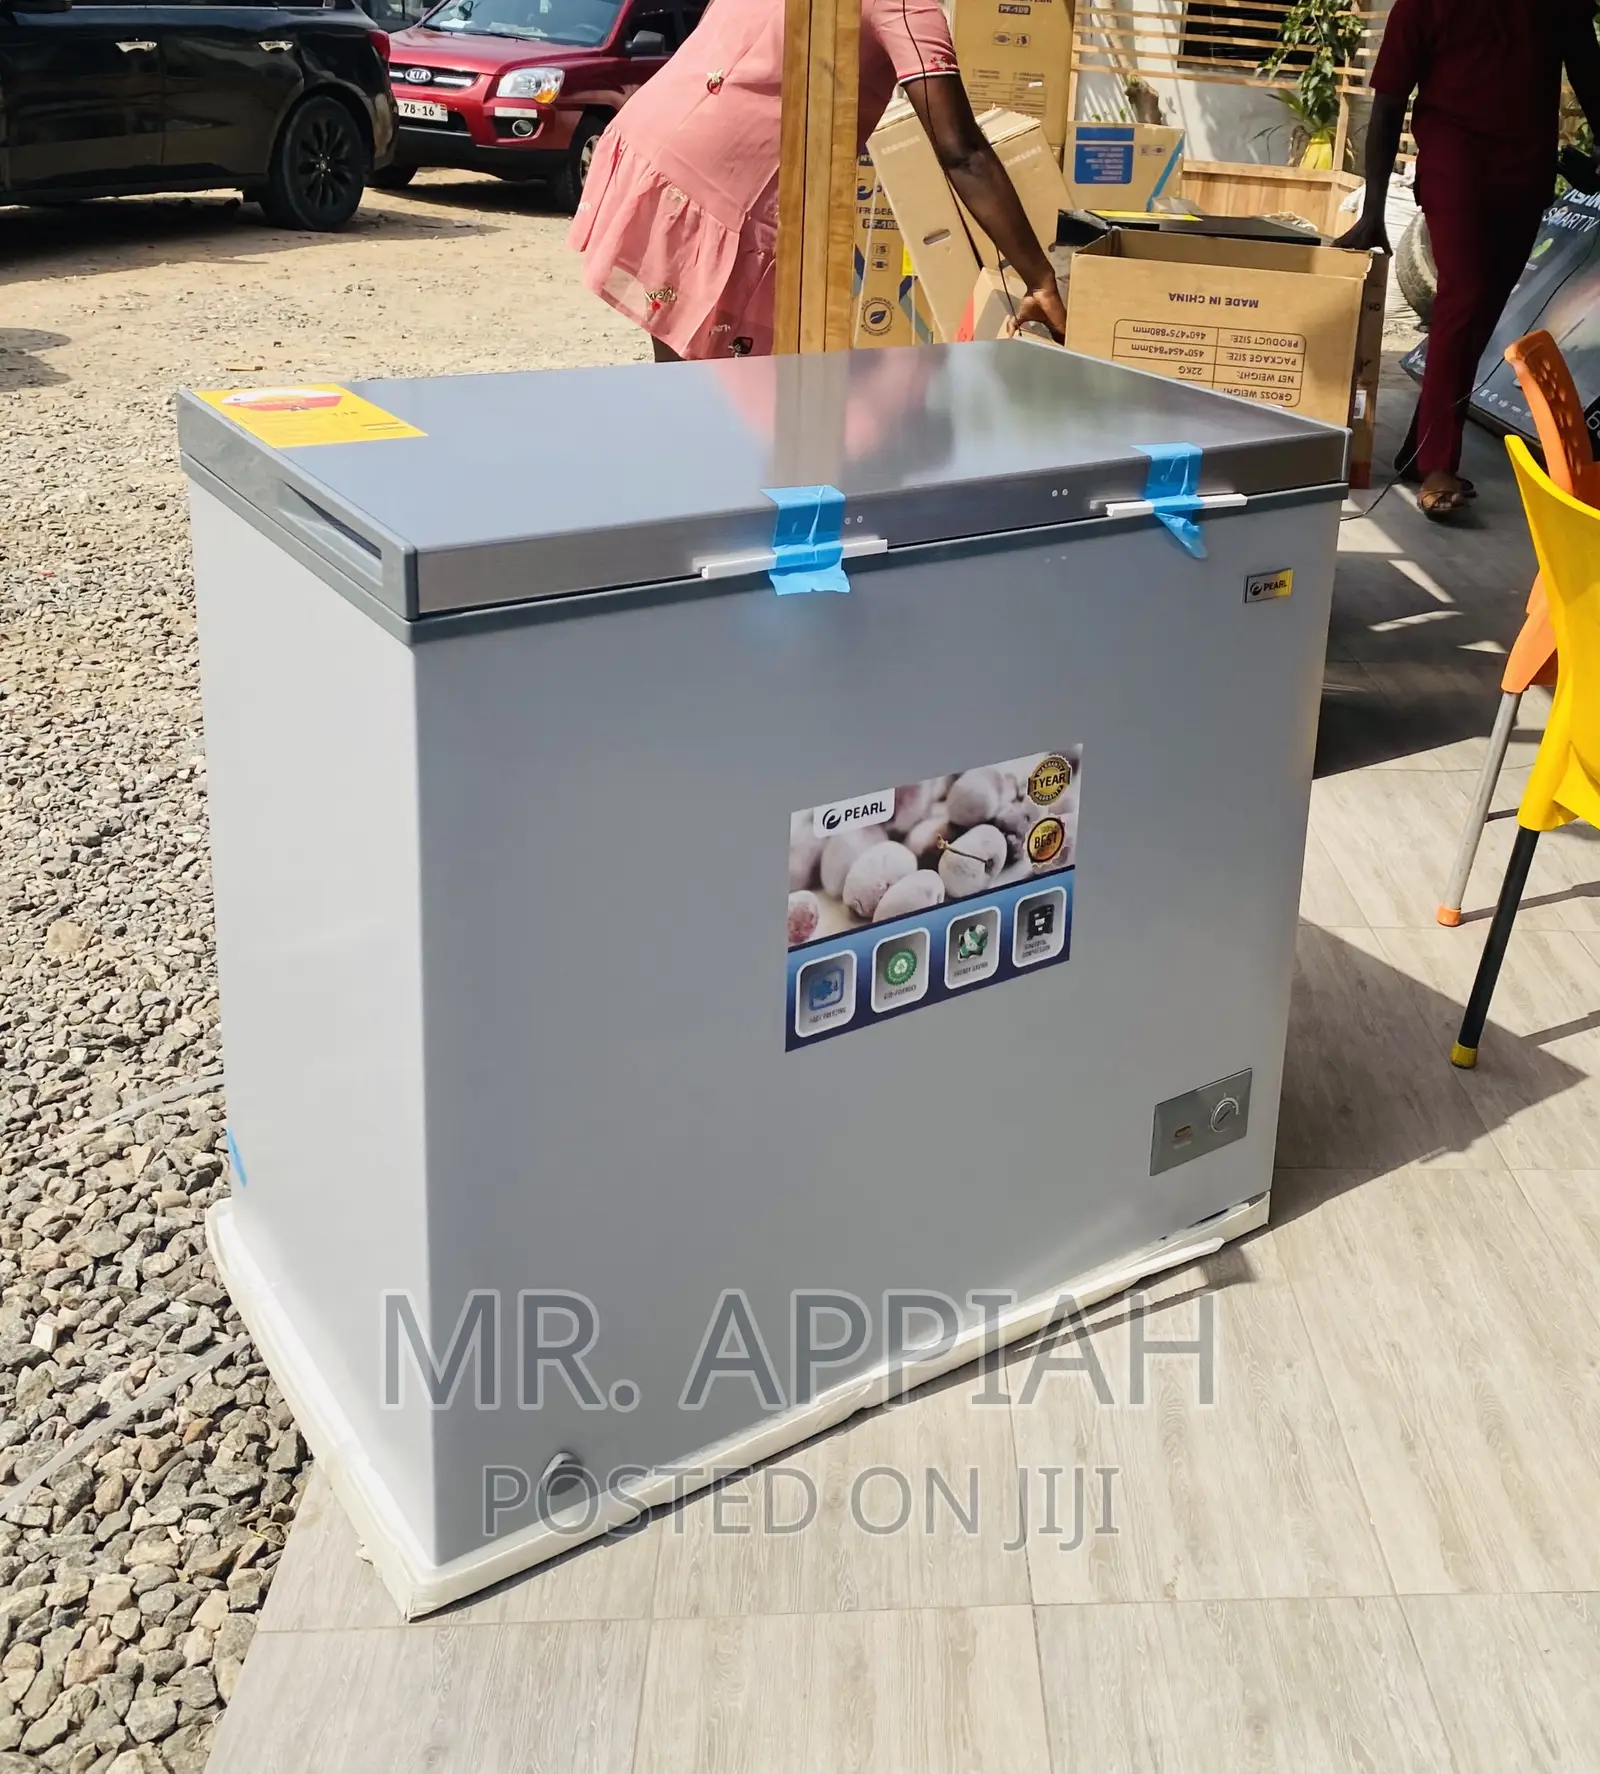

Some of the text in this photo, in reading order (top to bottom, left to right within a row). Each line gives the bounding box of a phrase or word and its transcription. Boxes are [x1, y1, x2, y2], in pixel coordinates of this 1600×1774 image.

[409, 70, 427, 80] KIA
[403, 103, 435, 117] 78-16
[1168, 292, 1259, 308] MADE IN CHINA
[1230, 334, 1253, 344] SIZE:
[1254, 336, 1299, 348] PRODUCT
[1226, 351, 1247, 362] SIZE:
[1250, 355, 1297, 366] PACKAGE
[1178, 365, 1295, 384] NET WEIGHT: 22KG
[1261, 392, 1293, 401] GROSS
[1263, 579, 1288, 591] PEARL
[1039, 773, 1066, 788] YEAR
[844, 801, 886, 821] PEARL
[1034, 832, 1058, 849] BEST
